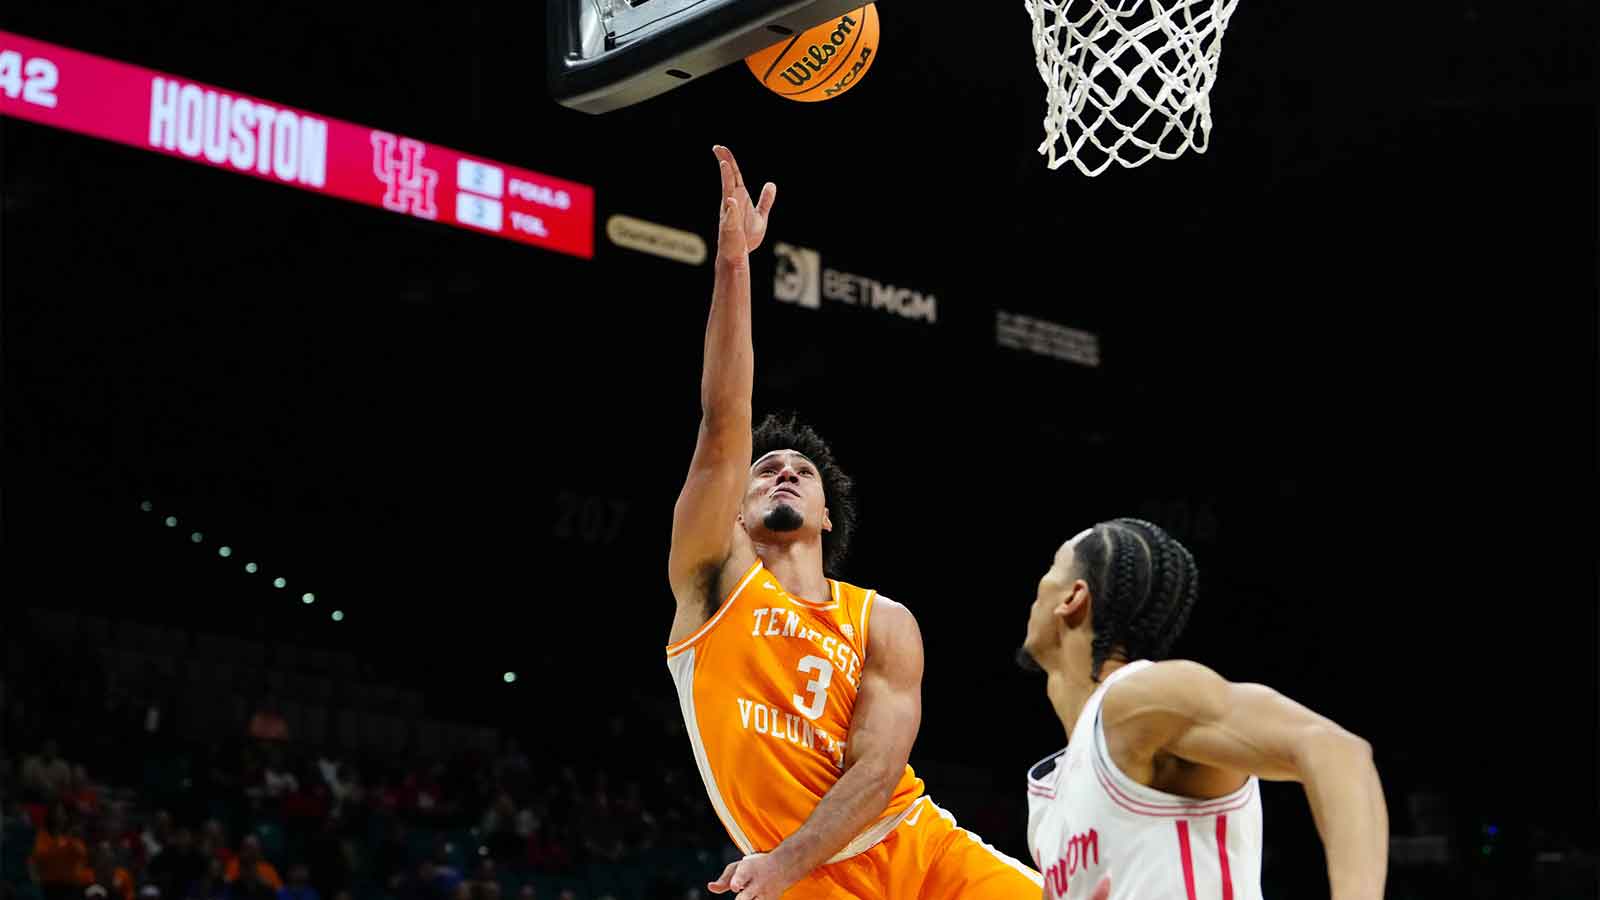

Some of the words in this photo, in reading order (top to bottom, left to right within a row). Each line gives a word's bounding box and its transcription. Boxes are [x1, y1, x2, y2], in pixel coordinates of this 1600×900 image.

[780, 15, 856, 86] Wilson
[824, 47, 872, 96] NCAA
[0, 49, 59, 109] 42
[149, 76, 327, 187] HOUSTON
[823, 268, 936, 324] BETMGM
[793, 655, 834, 720] 3
